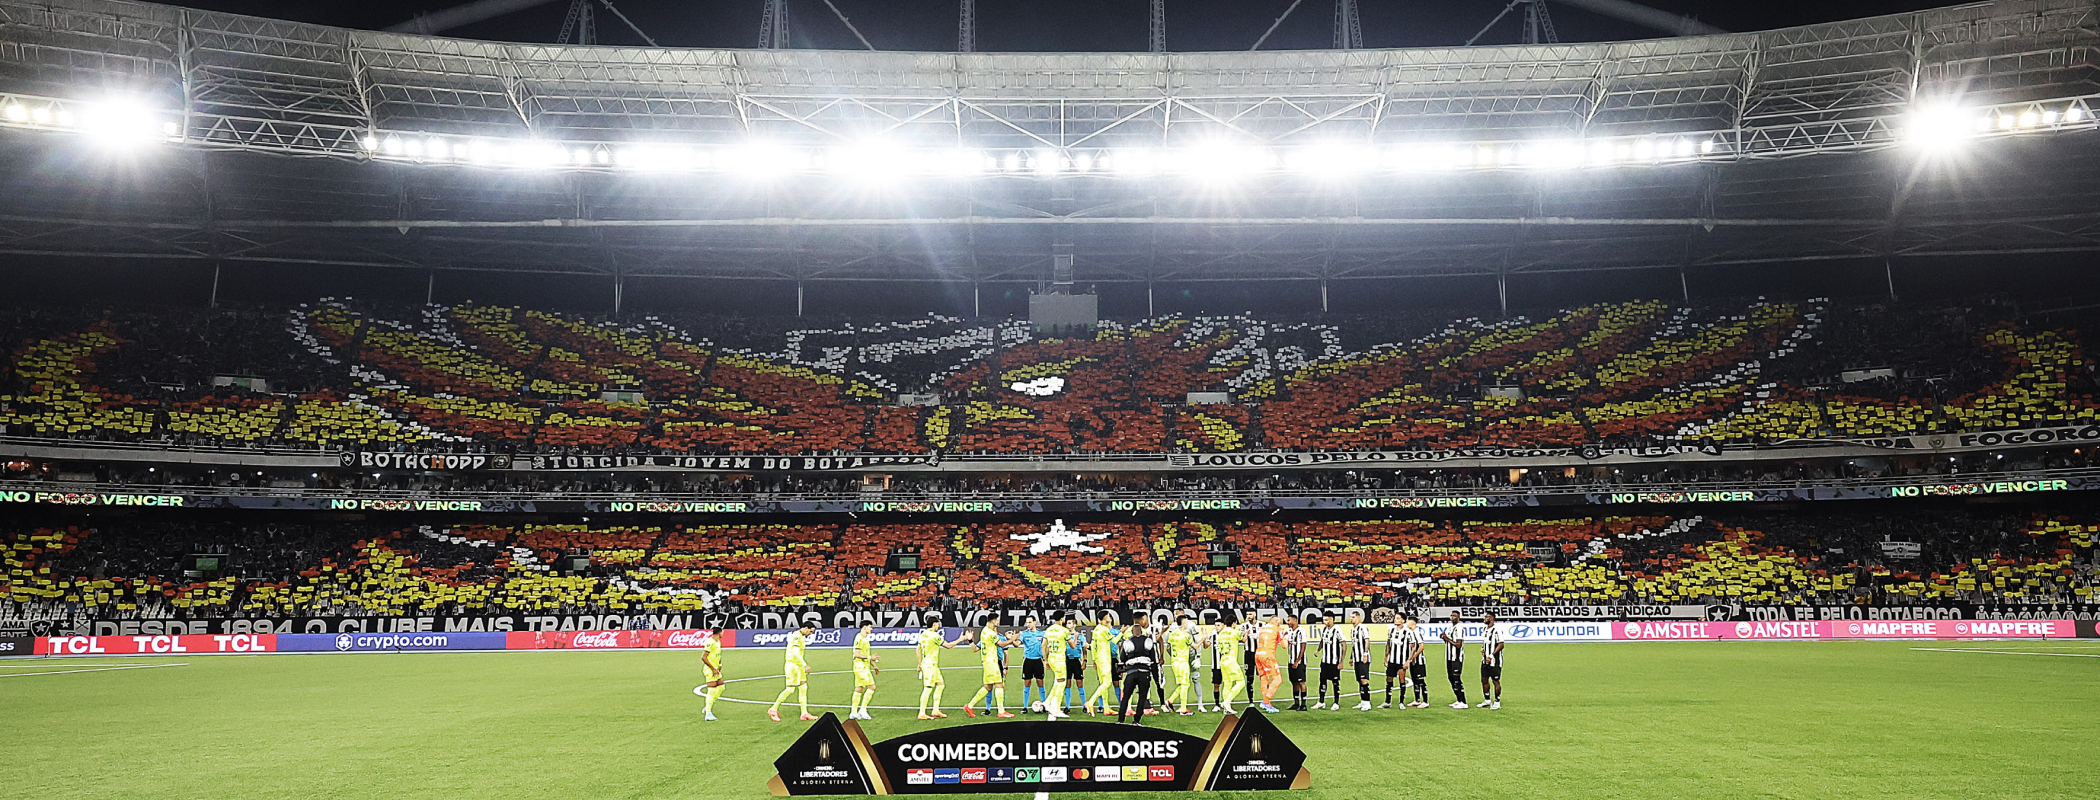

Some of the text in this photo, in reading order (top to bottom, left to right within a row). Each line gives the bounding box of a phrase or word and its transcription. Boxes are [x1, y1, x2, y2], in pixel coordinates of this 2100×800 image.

[552, 456, 655, 469] TORCIDA
[670, 456, 751, 469] JOVEM
[763, 457, 790, 469] DO
[1191, 454, 1301, 466] LOUCOS
[1310, 451, 1386, 464] PELO
[1892, 486, 1919, 497] NO
[1980, 479, 2068, 493] VENCER
[0, 491, 31, 503] NO
[101, 494, 183, 507] VENCER
[331, 499, 358, 510] NO
[413, 501, 482, 511] VENCER
[1356, 498, 1378, 508] NO
[1425, 497, 1487, 507] VENCER
[1612, 493, 1635, 504] NO
[1686, 491, 1754, 502] VENCER
[611, 501, 634, 512] NO
[683, 502, 746, 513] VENCER
[863, 501, 886, 512] NO
[932, 502, 993, 512] VENCER
[1112, 501, 1134, 511] NO
[1181, 500, 1241, 510] VENCER
[1523, 606, 1590, 617] SENTADOS
[1594, 606, 1603, 616] A
[1745, 606, 1789, 621] TODA
[1820, 606, 1862, 620] PELO
[1868, 606, 1962, 620] BOTAFOGO
[95, 620, 208, 636] DESDE
[221, 619, 293, 635] 1894
[338, 617, 435, 633] CLUBE
[444, 616, 514, 632] MAIS
[523, 614, 692, 631] TRADICINAL
[763, 611, 822, 629] DAS
[1429, 626, 1486, 637] HYNDA
[1537, 624, 1600, 636] HYUNDAI
[1643, 622, 1707, 639] AMSTEL
[1754, 621, 1820, 637] AMSTEL
[1862, 622, 1937, 635] MAPFRE
[1971, 622, 2056, 635] MAPFRE
[133, 635, 187, 652] TCL
[214, 634, 266, 651] TCL
[357, 634, 448, 649] crypto.com
[573, 631, 620, 648] Coca-Cola
[668, 630, 713, 647] Coca-Col
[752, 629, 841, 645] sportgbet
[48, 636, 105, 654] TCL
[897, 740, 1179, 762] CONMEBOL LIBERTADORES
[1150, 769, 1173, 777] TCL
